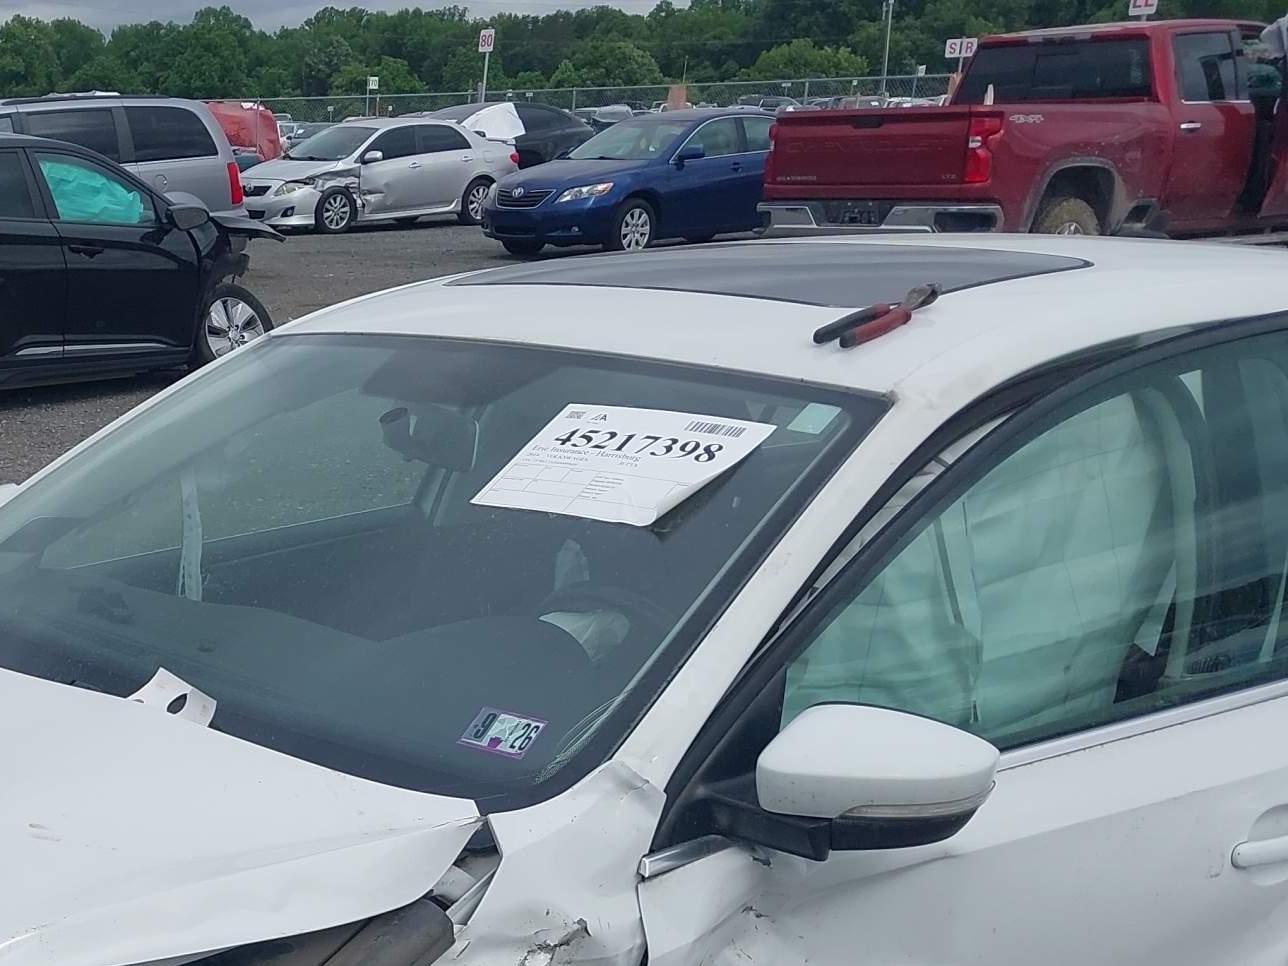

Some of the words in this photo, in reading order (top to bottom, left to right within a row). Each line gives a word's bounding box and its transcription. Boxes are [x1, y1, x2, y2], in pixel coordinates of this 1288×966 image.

[480, 34, 493, 47] 80
[949, 42, 958, 55] S
[965, 41, 974, 54] R
[554, 428, 724, 463] 45217398
[551, 446, 590, 456] Insurance
[595, 450, 642, 463] Harrisburg
[473, 712, 497, 739] 9
[509, 722, 540, 751] 26
